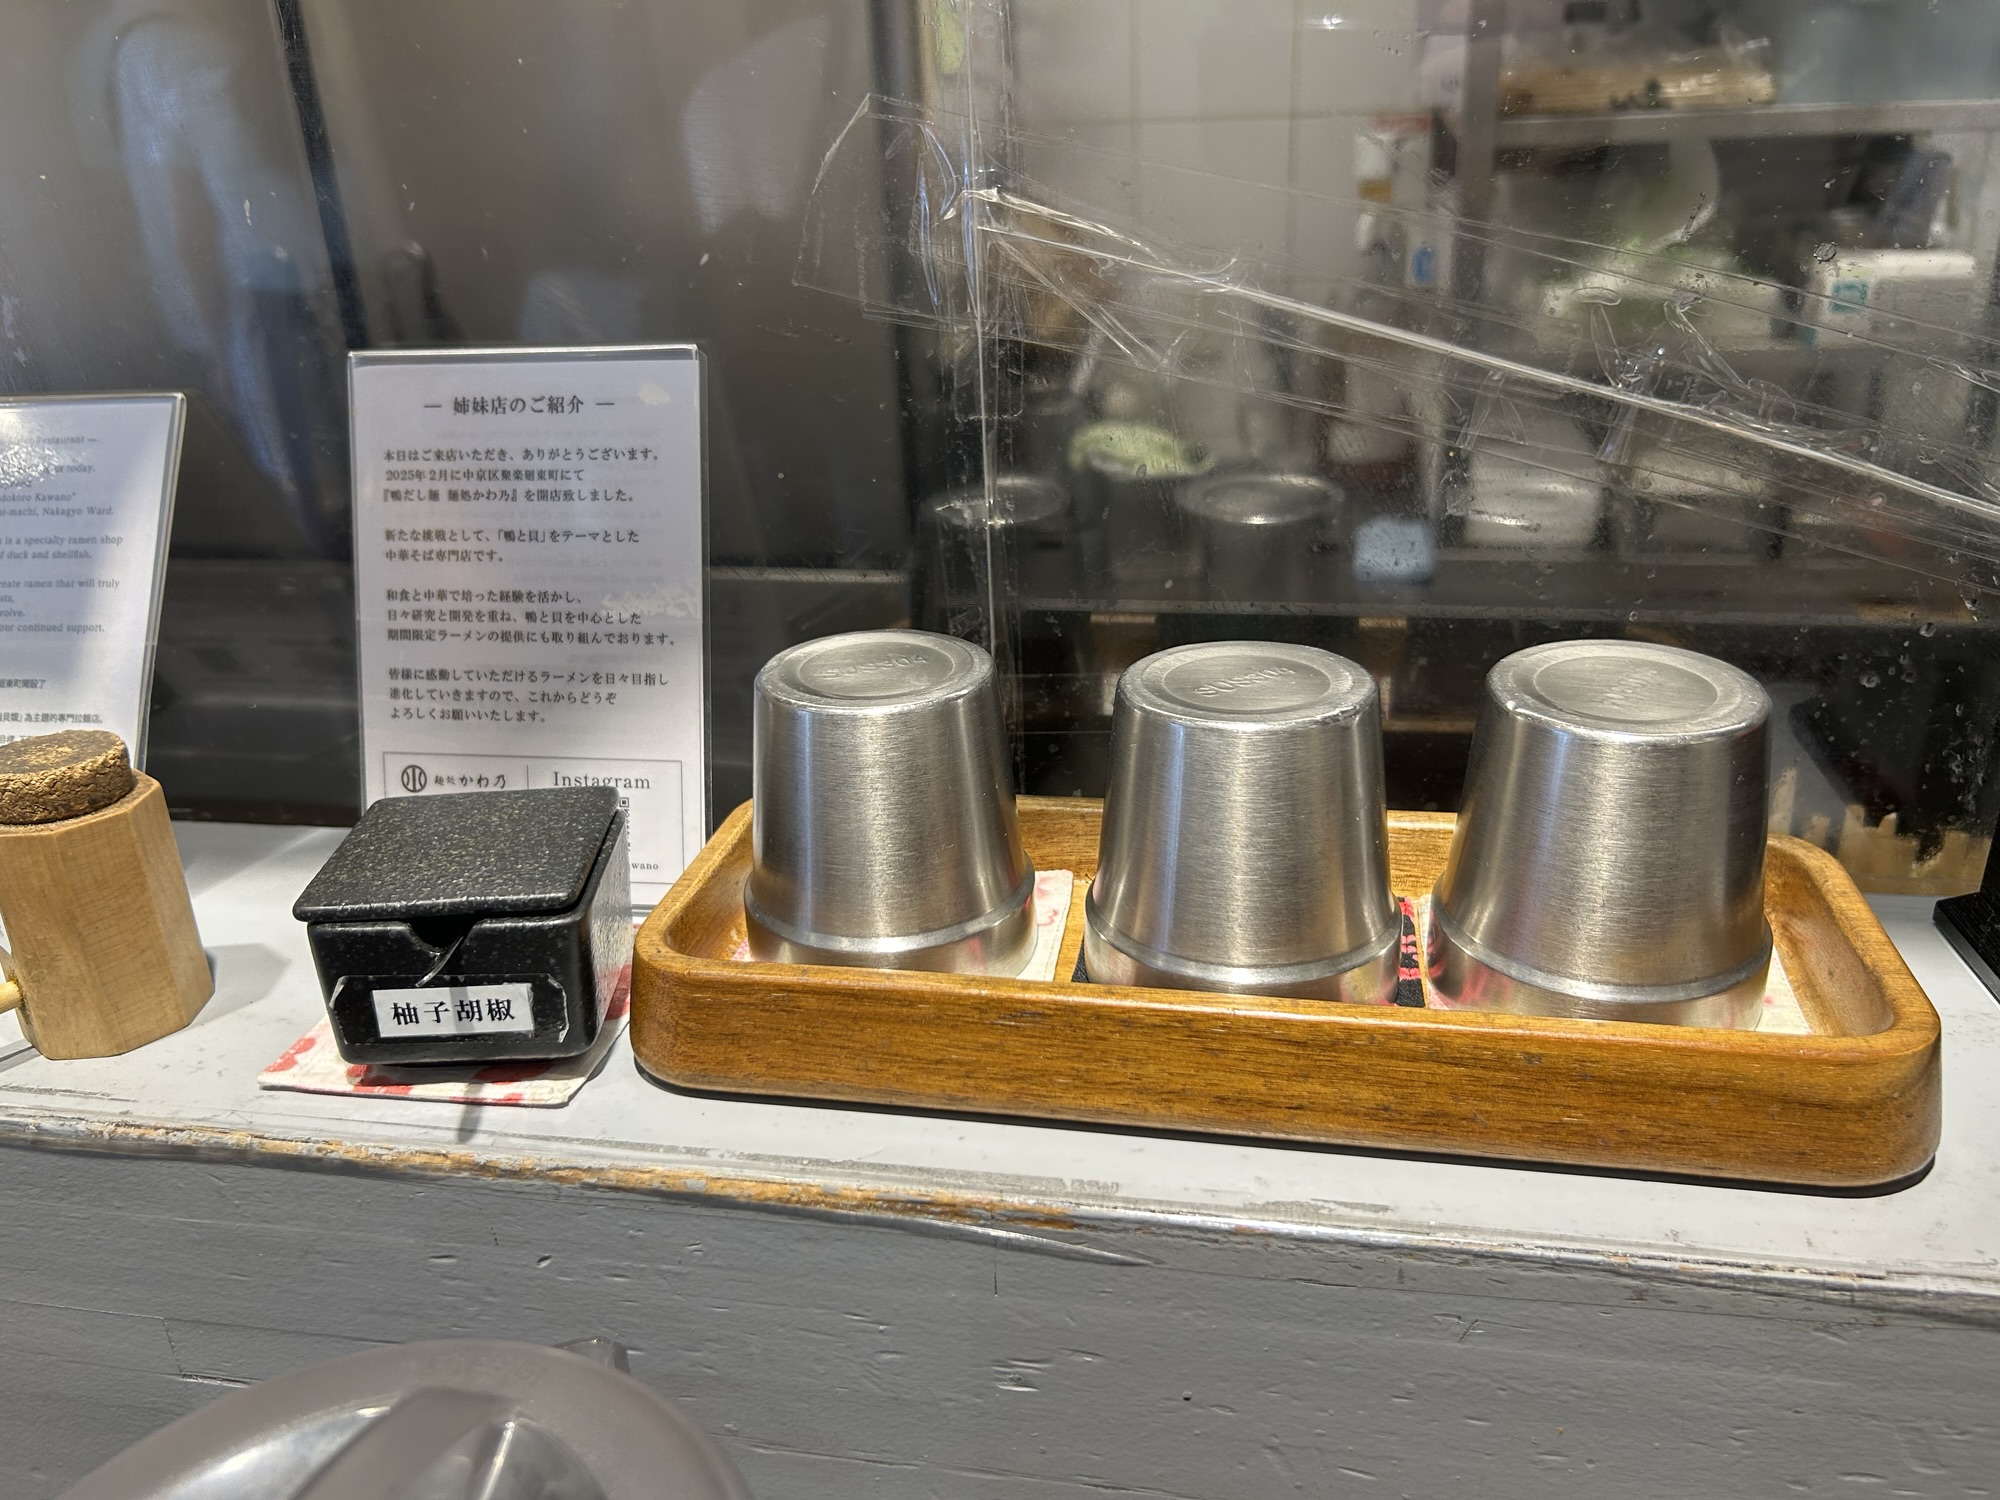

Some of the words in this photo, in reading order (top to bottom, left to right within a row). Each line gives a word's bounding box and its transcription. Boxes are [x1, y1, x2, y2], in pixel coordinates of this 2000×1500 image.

[453, 395, 585, 416] 姉妹店のご紹介
[384, 447, 660, 463] 本日はご来店いただき、ありがとうございます。
[67, 463, 96, 474] today.
[0, 492, 32, 502] dokoro
[42, 505, 83, 518] Nakagyo
[87, 505, 115, 516] Ward.
[5, 535, 13, 545] is
[24, 534, 65, 547] specialty
[68, 536, 97, 545] ramen
[100, 534, 123, 546] shop
[7, 549, 28, 559] duck
[31, 550, 49, 559] and
[52, 549, 92, 559] shellfish.
[385, 549, 504, 562] 中華そば専門店です。
[0, 579, 21, 588] reate
[24, 580, 53, 588] ramen
[56, 578, 75, 588] that
[78, 578, 95, 588] will
[98, 578, 121, 590] truly
[386, 588, 582, 604] 和食と中華で培った経験を活かし、
[0, 607, 26, 617] volve.
[387, 609, 642, 625] 日々研究と開発を重ね、鴨と貝を中心とした
[17, 623, 64, 633] continued
[66, 624, 105, 635] support.
[387, 628, 676, 647] 期間限定ラーメンの提供にも取り組んでおります。
[388, 667, 670, 687] 皆様に感動していただけるラーメンを日々目指し
[389, 687, 618, 705] 進化していきますので、これからどうぞ
[391, 707, 546, 723] よろしくお願いいたします。
[553, 771, 651, 790] Instagram
[631, 862, 659, 870] wano
[391, 997, 516, 1026] 柚子胡椒
